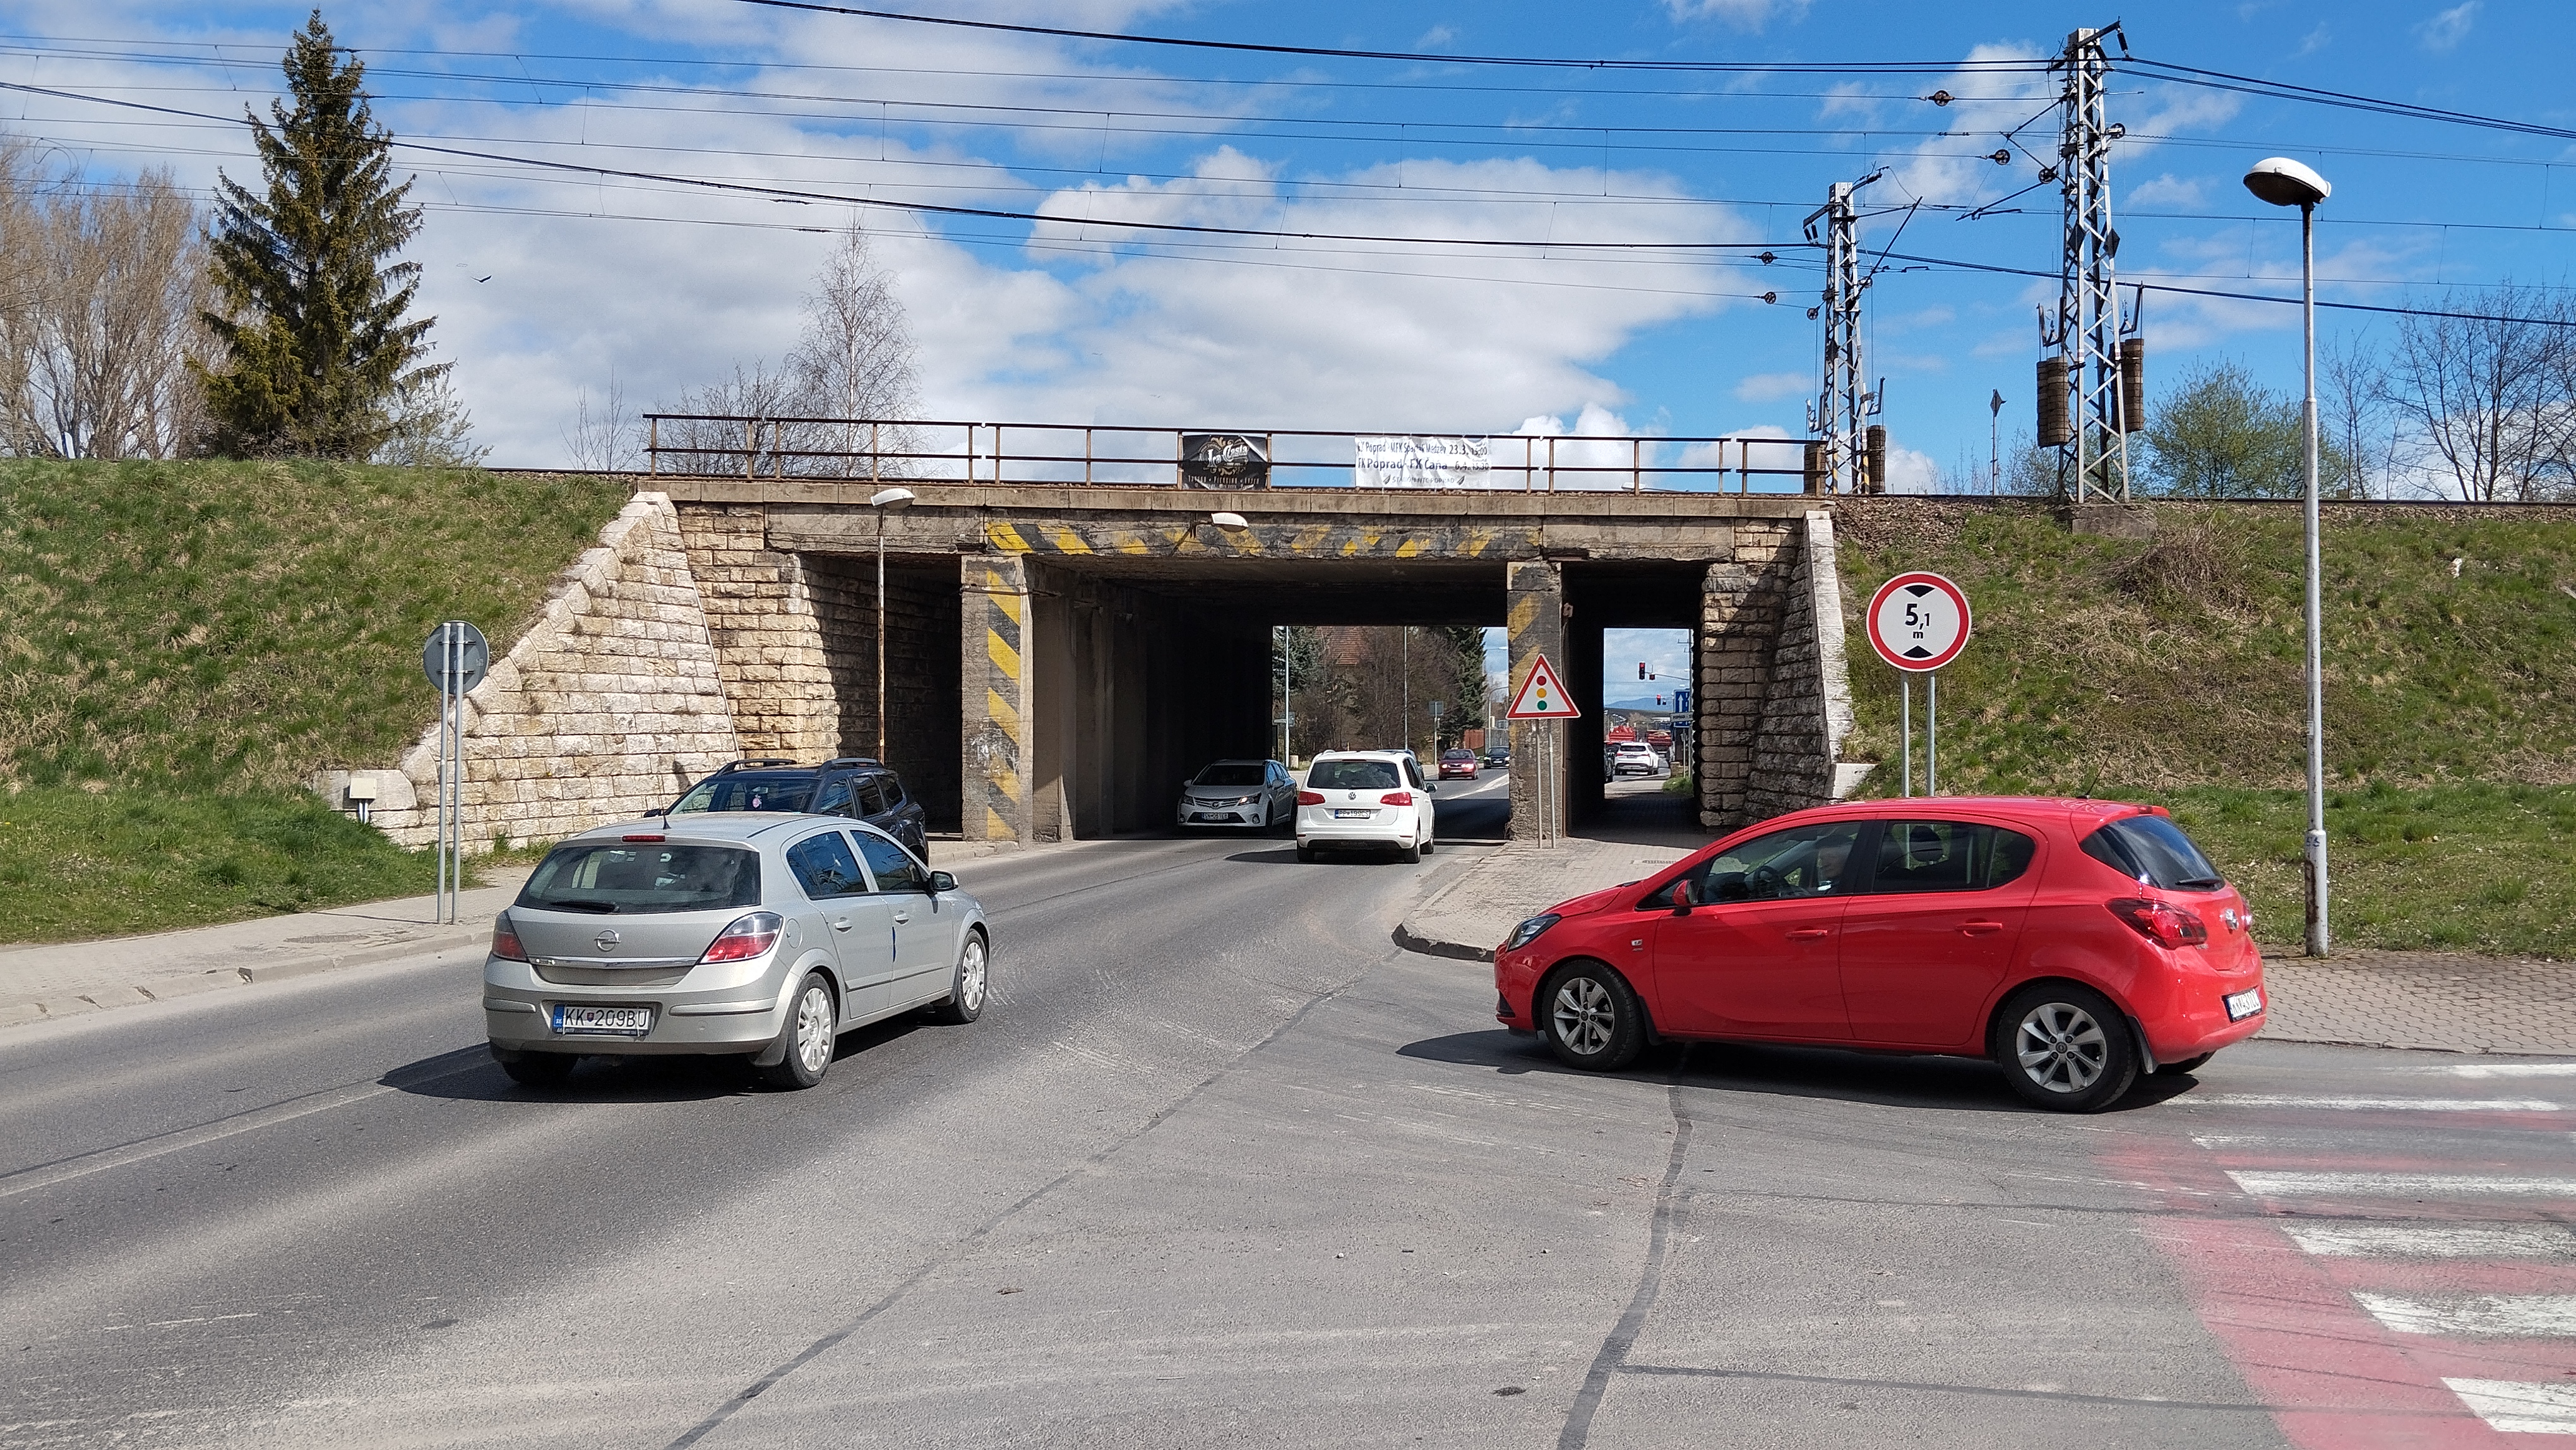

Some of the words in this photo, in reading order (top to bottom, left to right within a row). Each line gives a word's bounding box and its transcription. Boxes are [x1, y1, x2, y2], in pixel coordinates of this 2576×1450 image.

[1367, 458, 1402, 471] Poprad
[1905, 603, 1930, 630] 5,1
[565, 1008, 585, 1026] KK
[595, 1010, 648, 1027] 209BU
